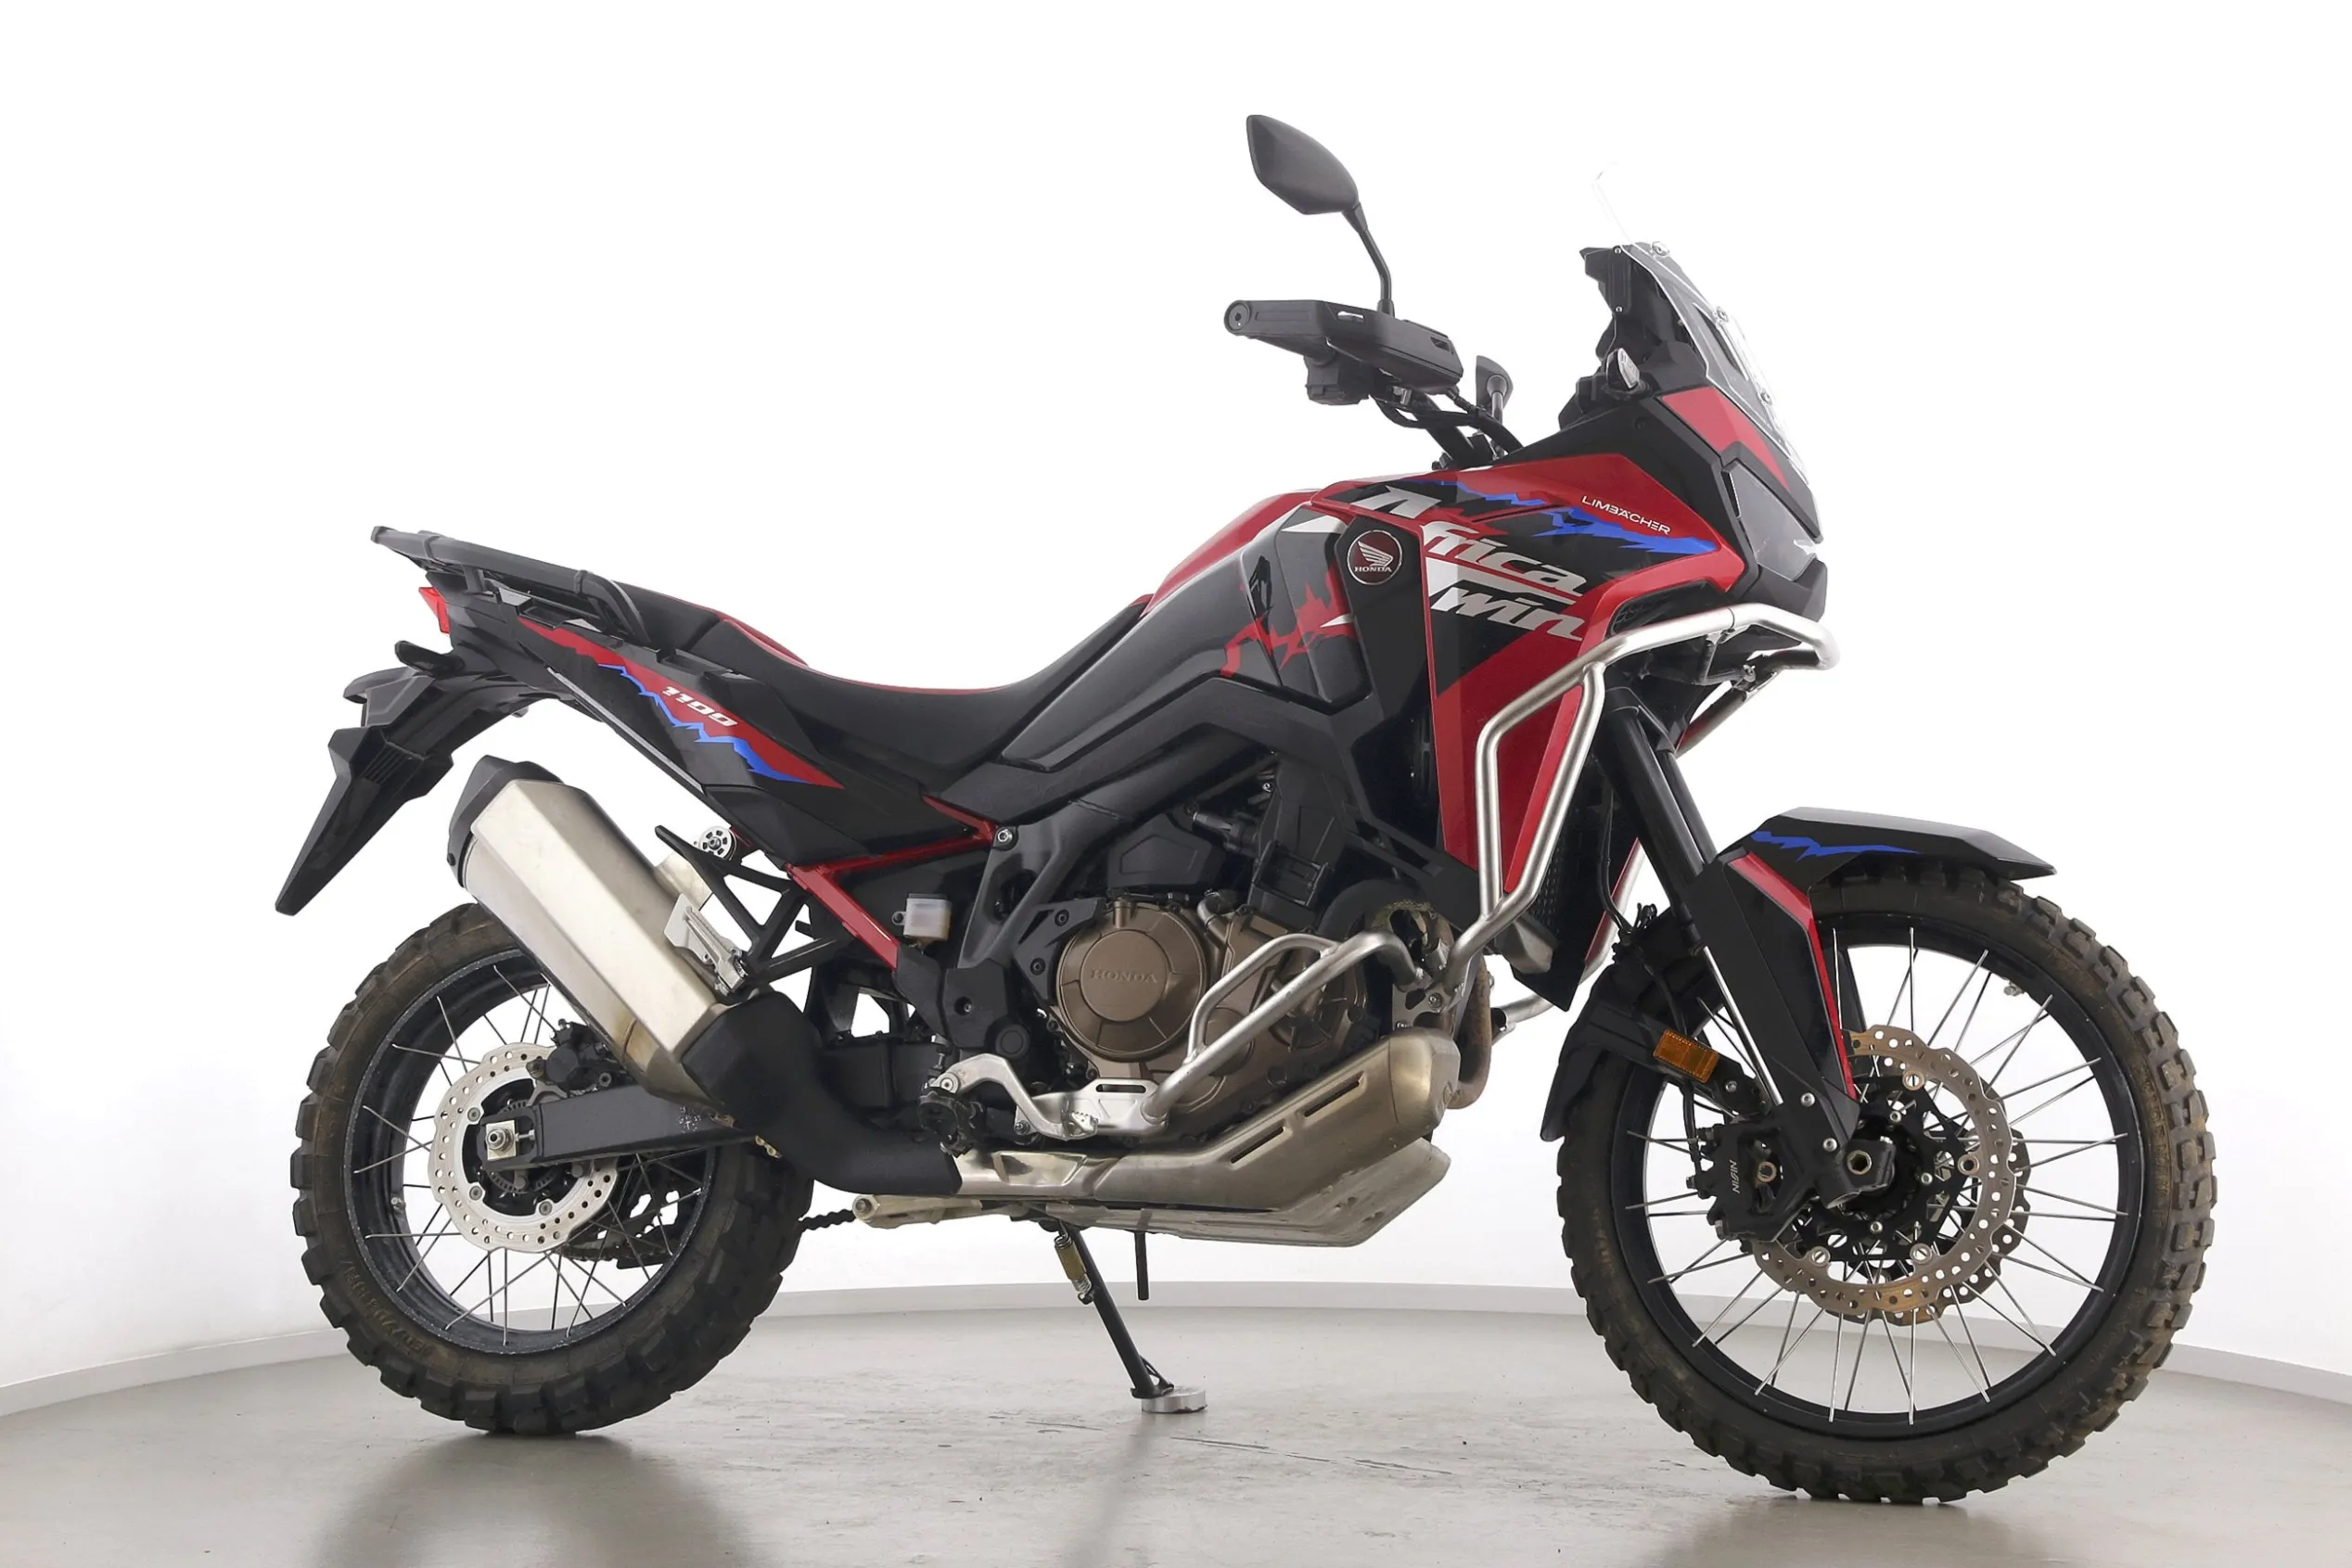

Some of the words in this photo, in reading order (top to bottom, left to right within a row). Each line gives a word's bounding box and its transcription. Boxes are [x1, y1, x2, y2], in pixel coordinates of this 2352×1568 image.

[1581, 495, 1671, 535] LIMBÄCHER
[662, 686, 737, 727] 1100
[1091, 969, 1157, 984] HONDA
